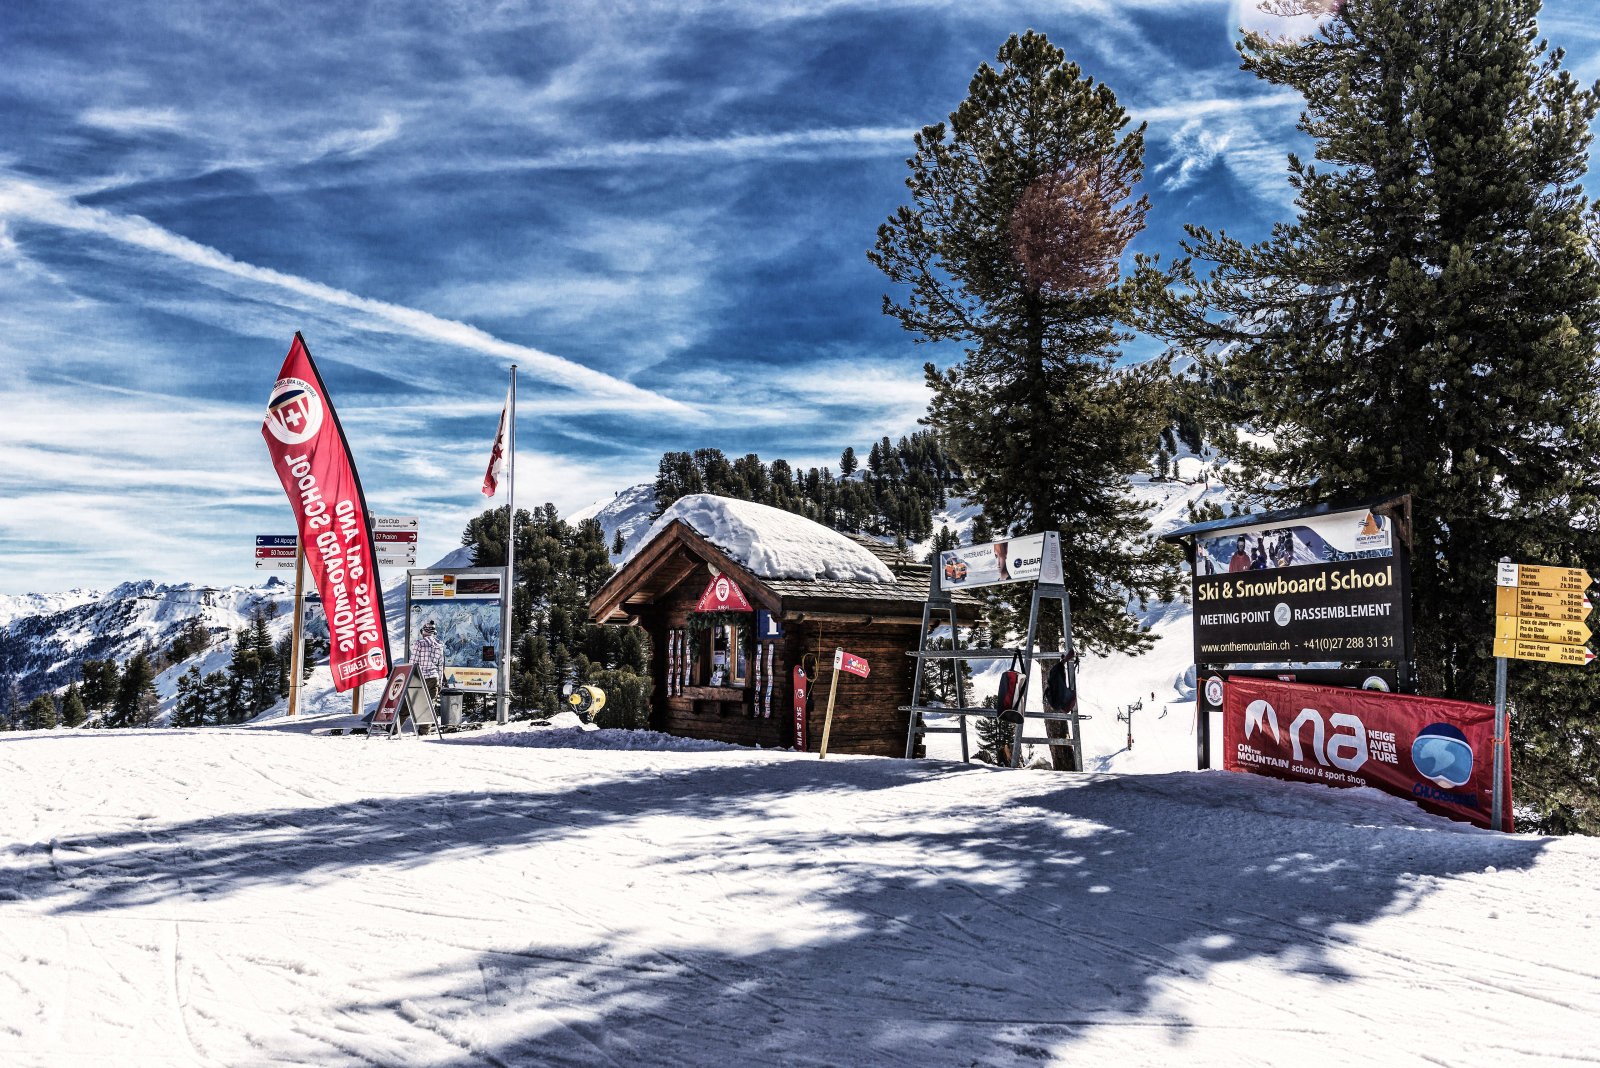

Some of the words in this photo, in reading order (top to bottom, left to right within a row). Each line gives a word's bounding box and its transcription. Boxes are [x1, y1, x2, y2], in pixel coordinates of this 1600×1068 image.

[1199, 582, 1219, 600] Ski
[1222, 582, 1233, 599] &
[1236, 572, 1326, 597] Snowboard
[1331, 566, 1392, 591] School
[1200, 612, 1239, 625] MEETING
[1241, 610, 1270, 623] POINT
[1277, 607, 1288, 622] 2
[1294, 603, 1392, 621] RASSEMBLEMENT
[1201, 640, 1290, 652] www.onthemountain.ch
[1304, 638, 1343, 651] +41(0)27
[1346, 637, 1364, 649] 288
[1366, 637, 1378, 647] 31
[1382, 636, 1393, 647] 31
[1290, 708, 1368, 772] na
[1368, 730, 1395, 742] NEIGE
[1238, 743, 1251, 753] ON
[1370, 740, 1396, 753] AVEN
[1238, 752, 1289, 768] MOUNTAIN
[1370, 750, 1398, 764] TURE
[1291, 765, 1316, 775] school
[1318, 769, 1323, 777] &
[1325, 771, 1345, 781] sport
[1347, 775, 1366, 786] shop
